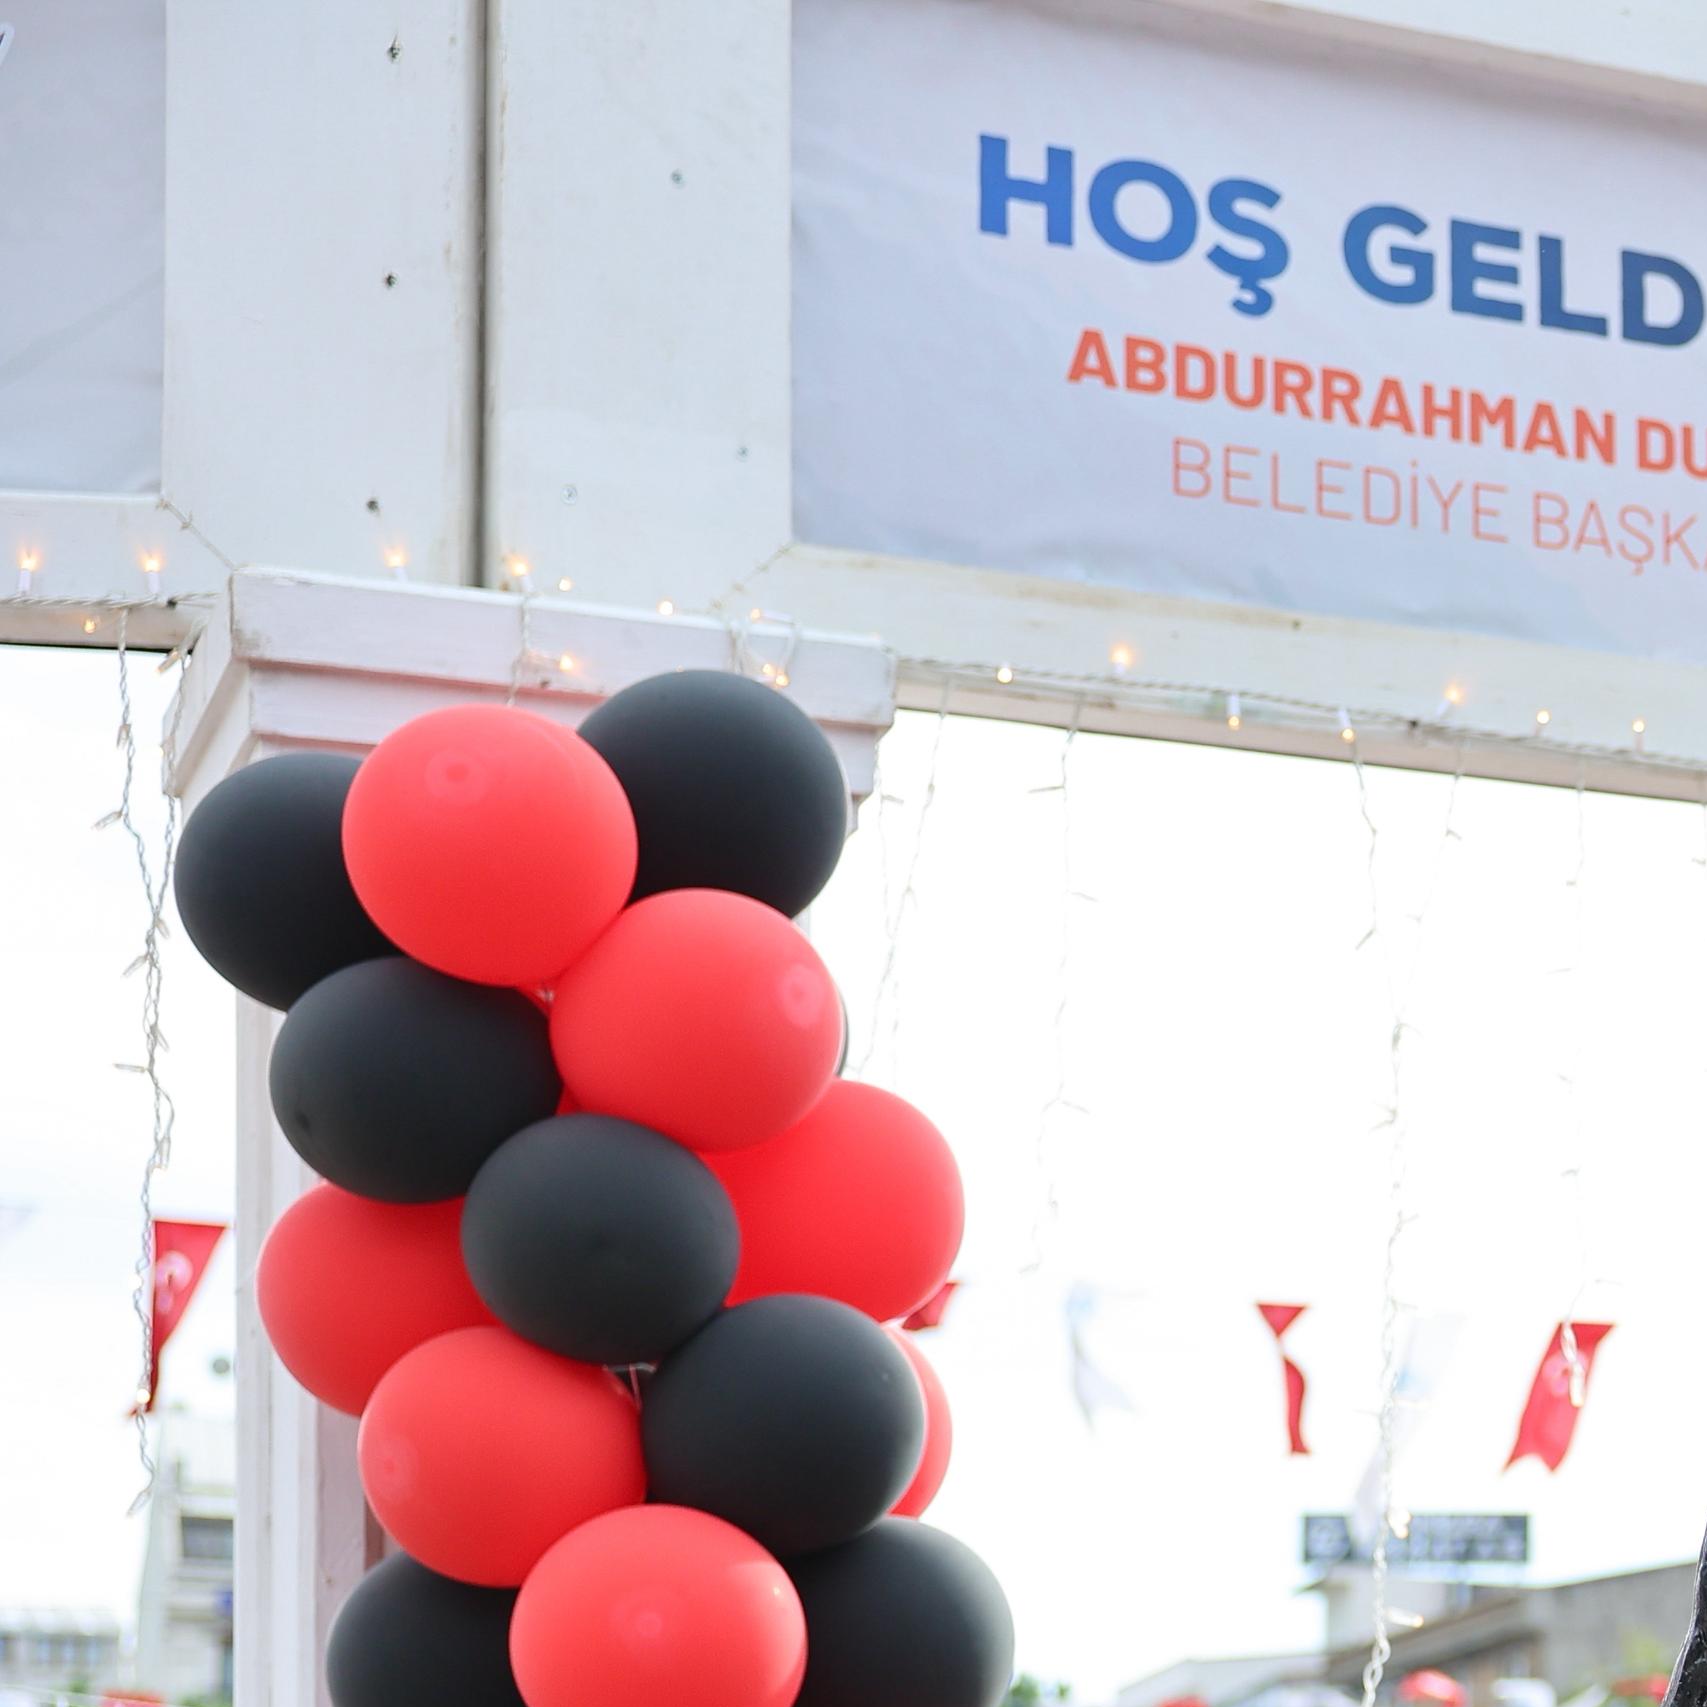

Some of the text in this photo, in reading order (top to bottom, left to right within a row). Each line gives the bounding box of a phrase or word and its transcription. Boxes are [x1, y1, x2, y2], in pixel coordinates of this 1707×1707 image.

[977, 131, 1292, 319] HOŞ
[1066, 327, 1617, 466] ABDURRAHMAN
[1171, 436, 1508, 544] BELEDİYE
